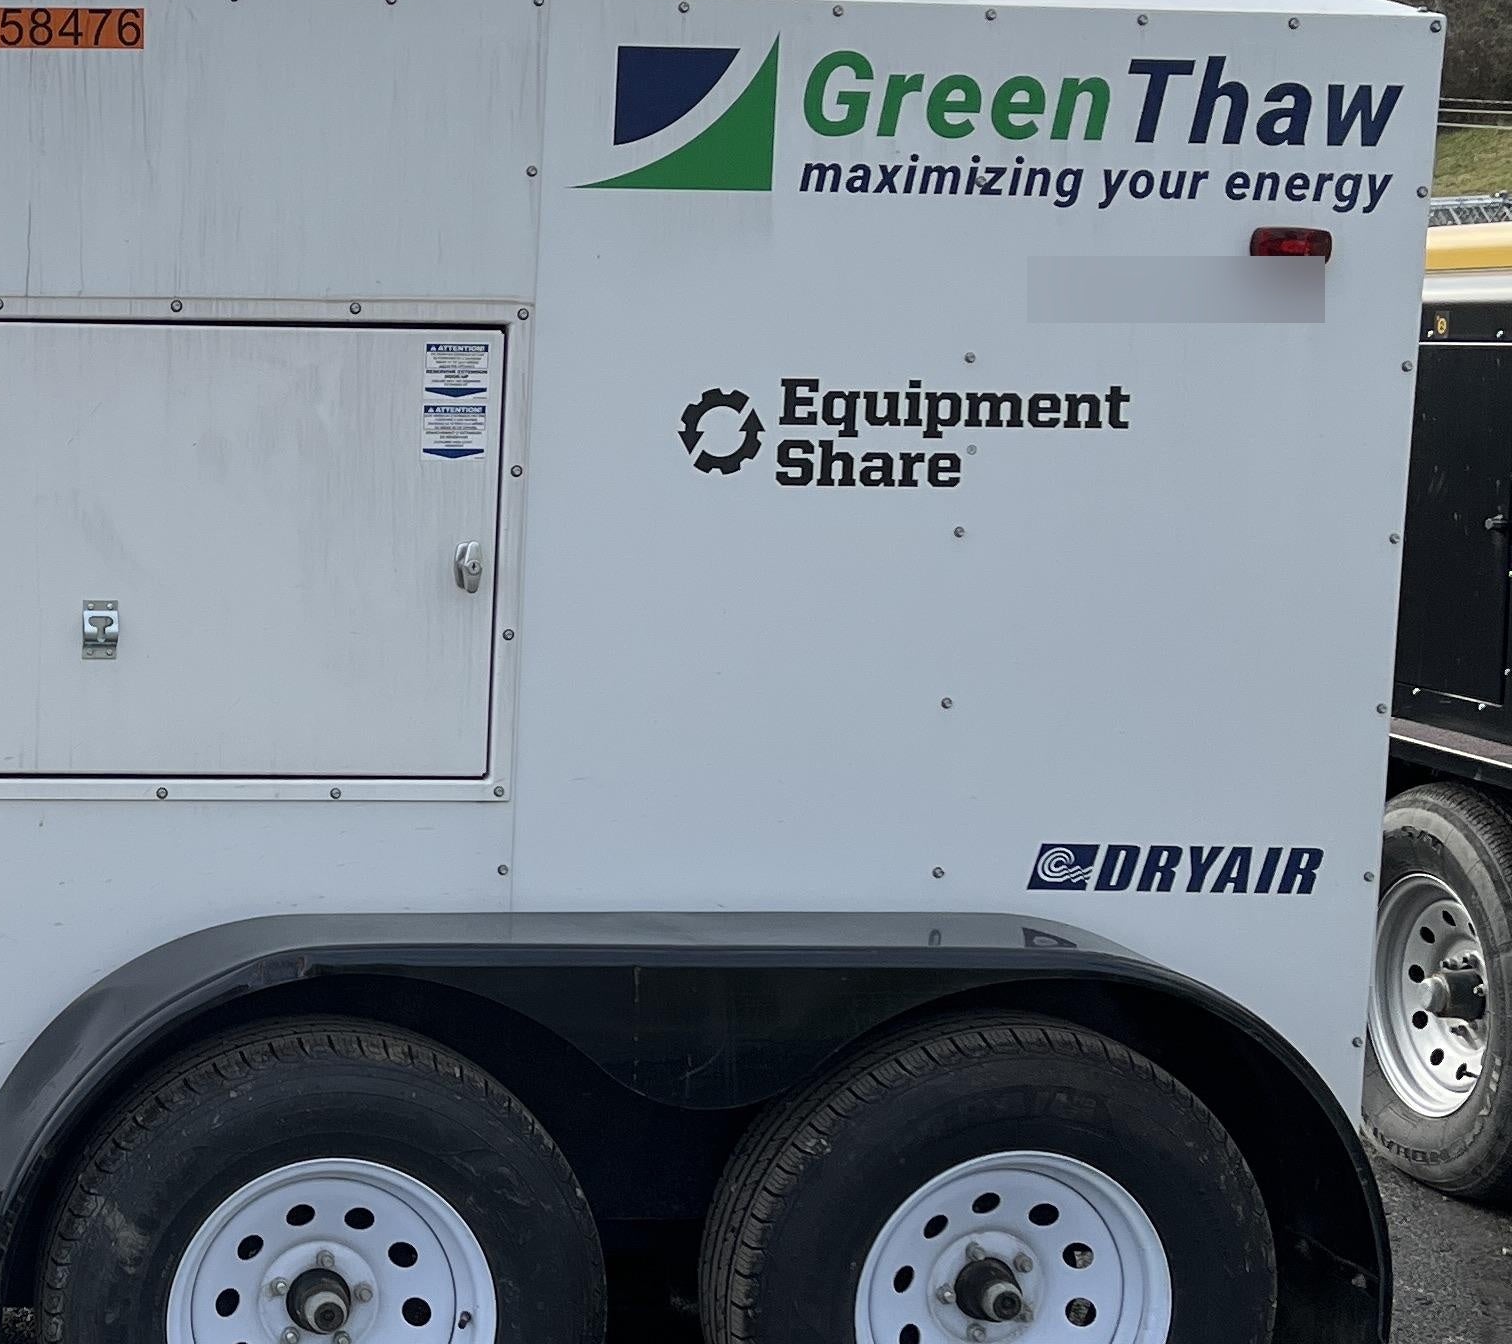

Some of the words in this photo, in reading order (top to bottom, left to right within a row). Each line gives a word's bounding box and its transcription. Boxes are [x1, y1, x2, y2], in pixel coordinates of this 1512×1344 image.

[803, 50, 1404, 147] GreenThaw
[799, 153, 1084, 208] maximizing
[1098, 167, 1209, 209] your
[1224, 168, 1394, 214] energy
[779, 378, 1131, 439] Equipment
[775, 440, 961, 487] Share
[1093, 844, 1325, 895] DRYAIR
